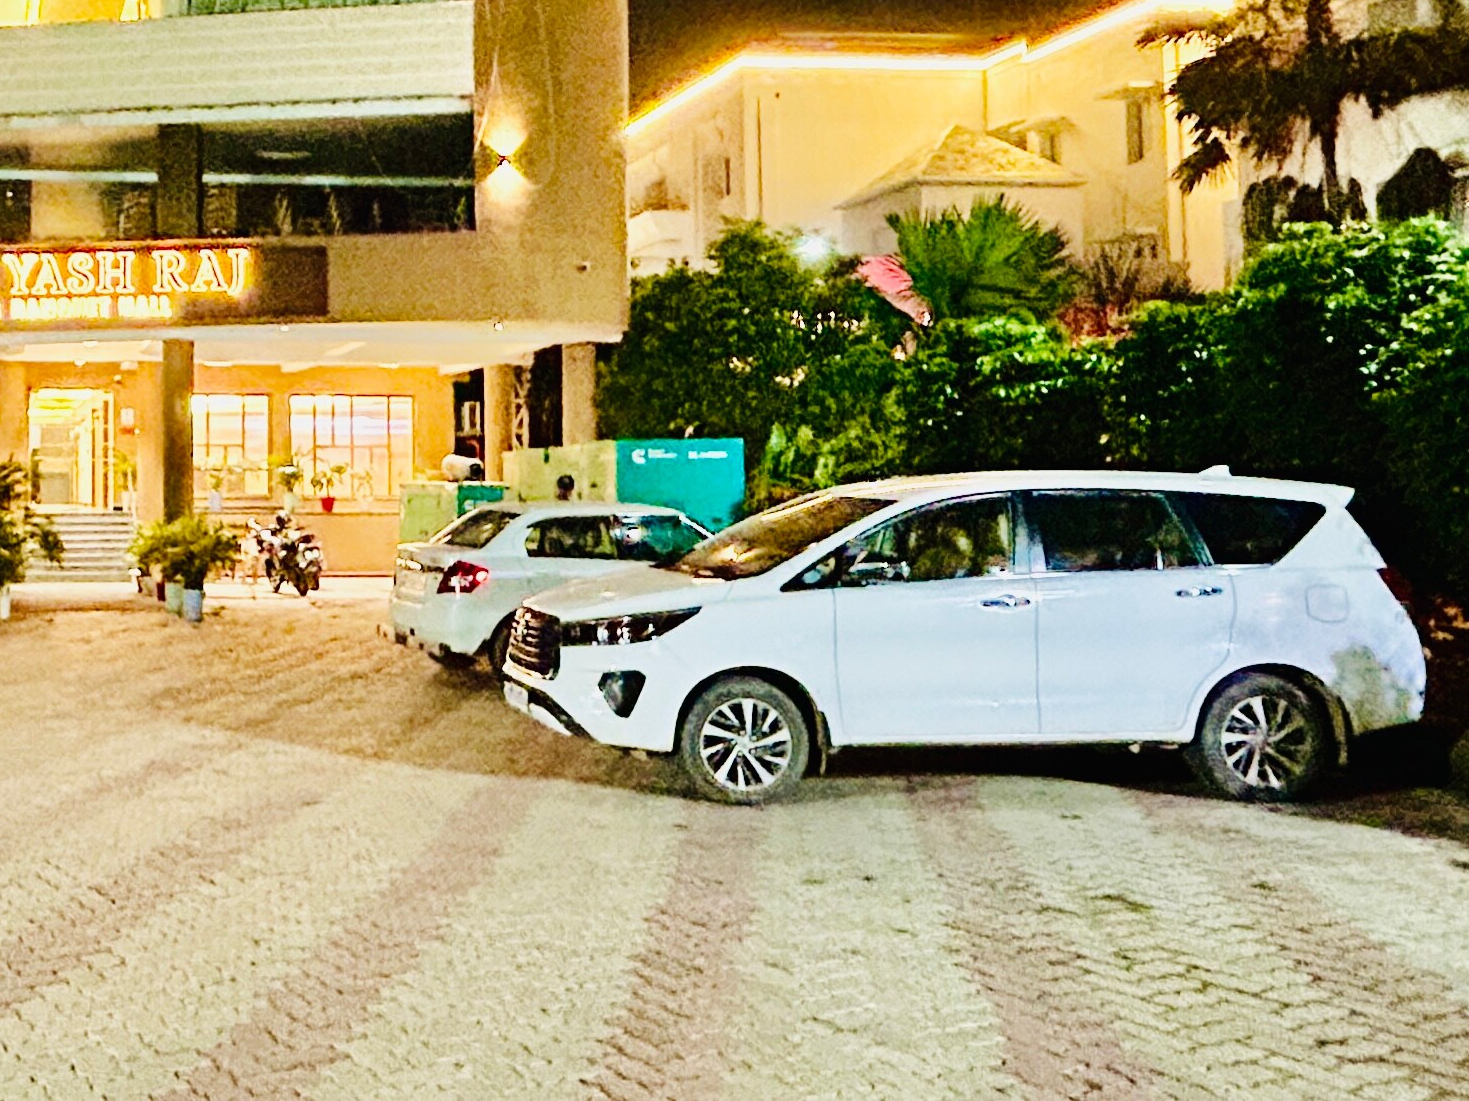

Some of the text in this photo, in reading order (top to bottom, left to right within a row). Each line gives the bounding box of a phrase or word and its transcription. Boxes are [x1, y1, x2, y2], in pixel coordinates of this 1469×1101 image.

[3, 250, 135, 295] YASH
[153, 248, 251, 296] RAJ
[117, 294, 173, 319] HALL
